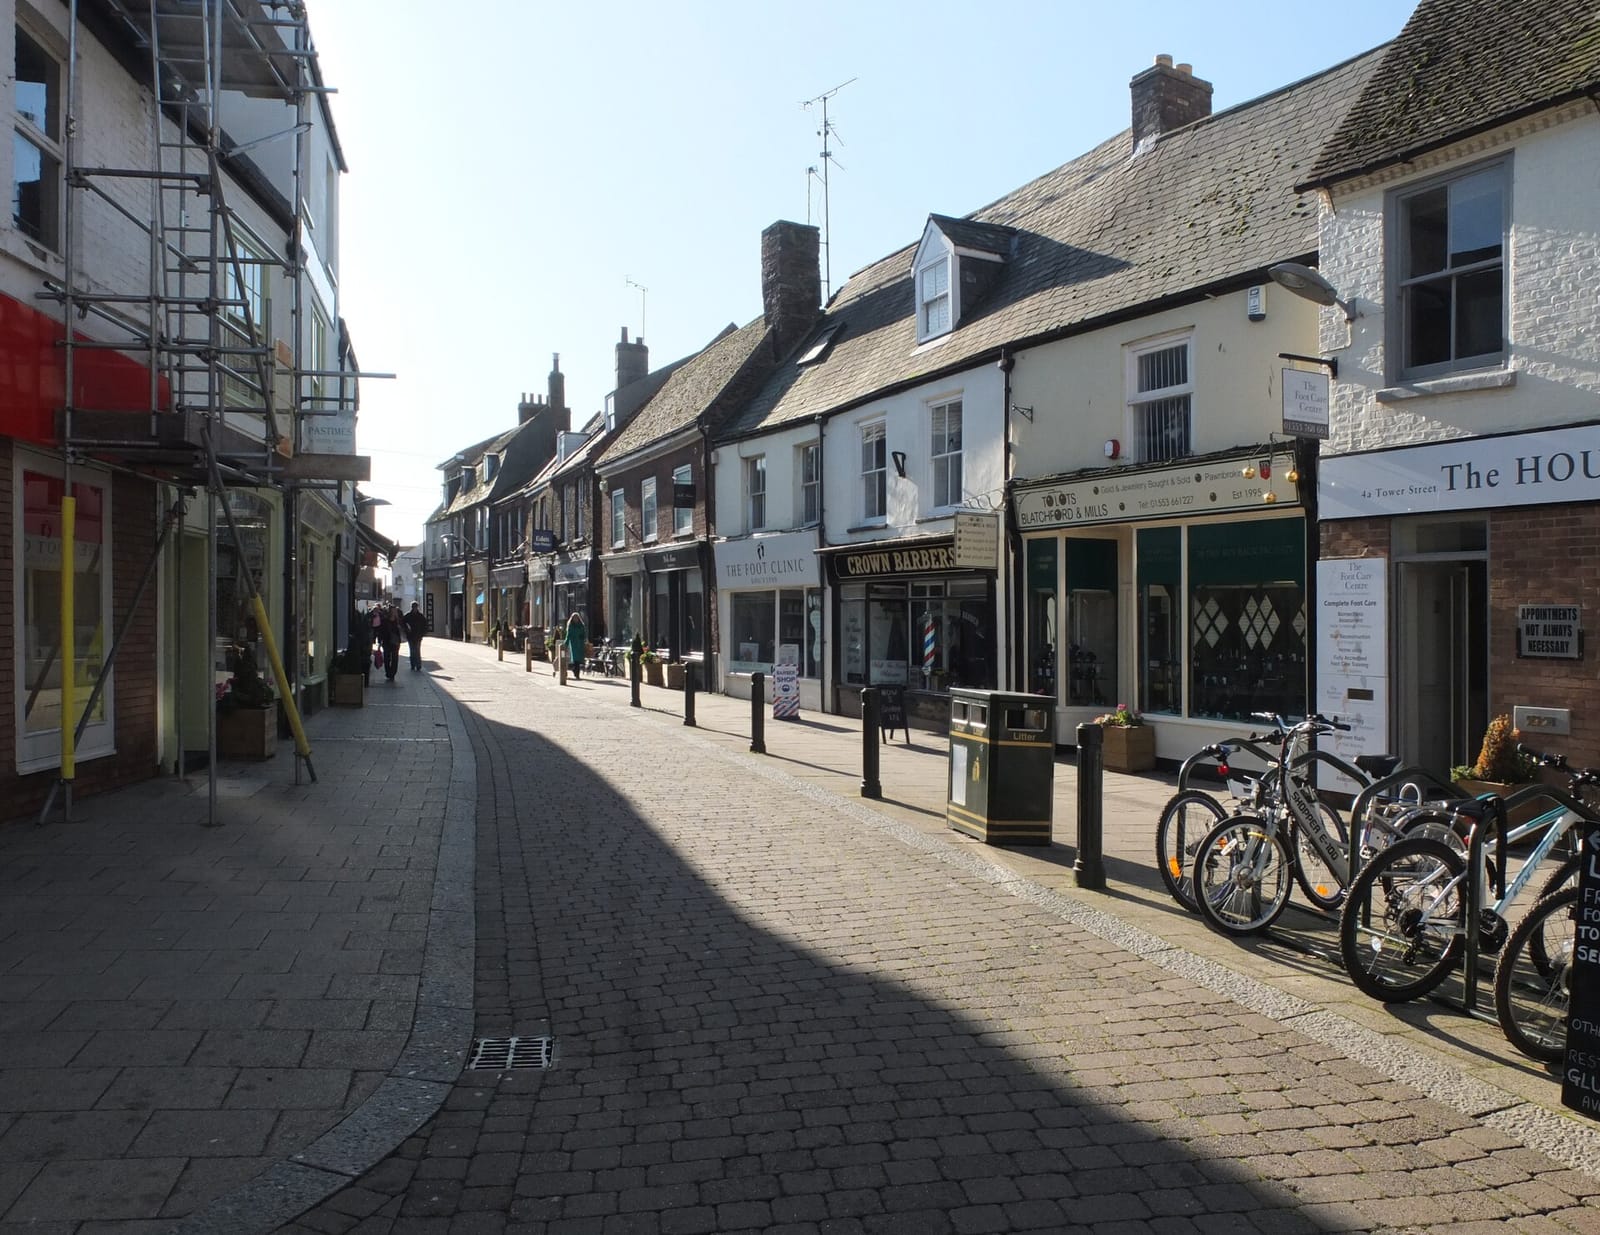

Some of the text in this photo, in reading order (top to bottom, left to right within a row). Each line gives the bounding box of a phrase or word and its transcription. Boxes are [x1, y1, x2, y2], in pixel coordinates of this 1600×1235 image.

[1304, 381, 1317, 392] The
[1295, 391, 1310, 401] Foot
[1177, 476, 1191, 485] Sold
[1375, 486, 1405, 498] Tower
[1408, 484, 1437, 495] Street
[1441, 461, 1500, 491] The
[1232, 490, 1243, 500] Est
[1021, 504, 1109, 525] BLATCHFORD & MILLS
[847, 547, 955, 575] CROWN BARBERS
[1349, 562, 1361, 571] The
[726, 558, 805, 577] THE FOOT CLINIC
[1340, 572, 1355, 581] Foot
[1344, 581, 1369, 590] Centre
[1521, 608, 1577, 620] APPOINTMENTS
[1525, 624, 1572, 637] NOT ALWAYS
[1528, 640, 1570, 653] NECESSARY
[1013, 731, 1036, 741] Litter
[1291, 791, 1339, 861] SHOPPER E-100
[1577, 945, 1600, 965] SE
